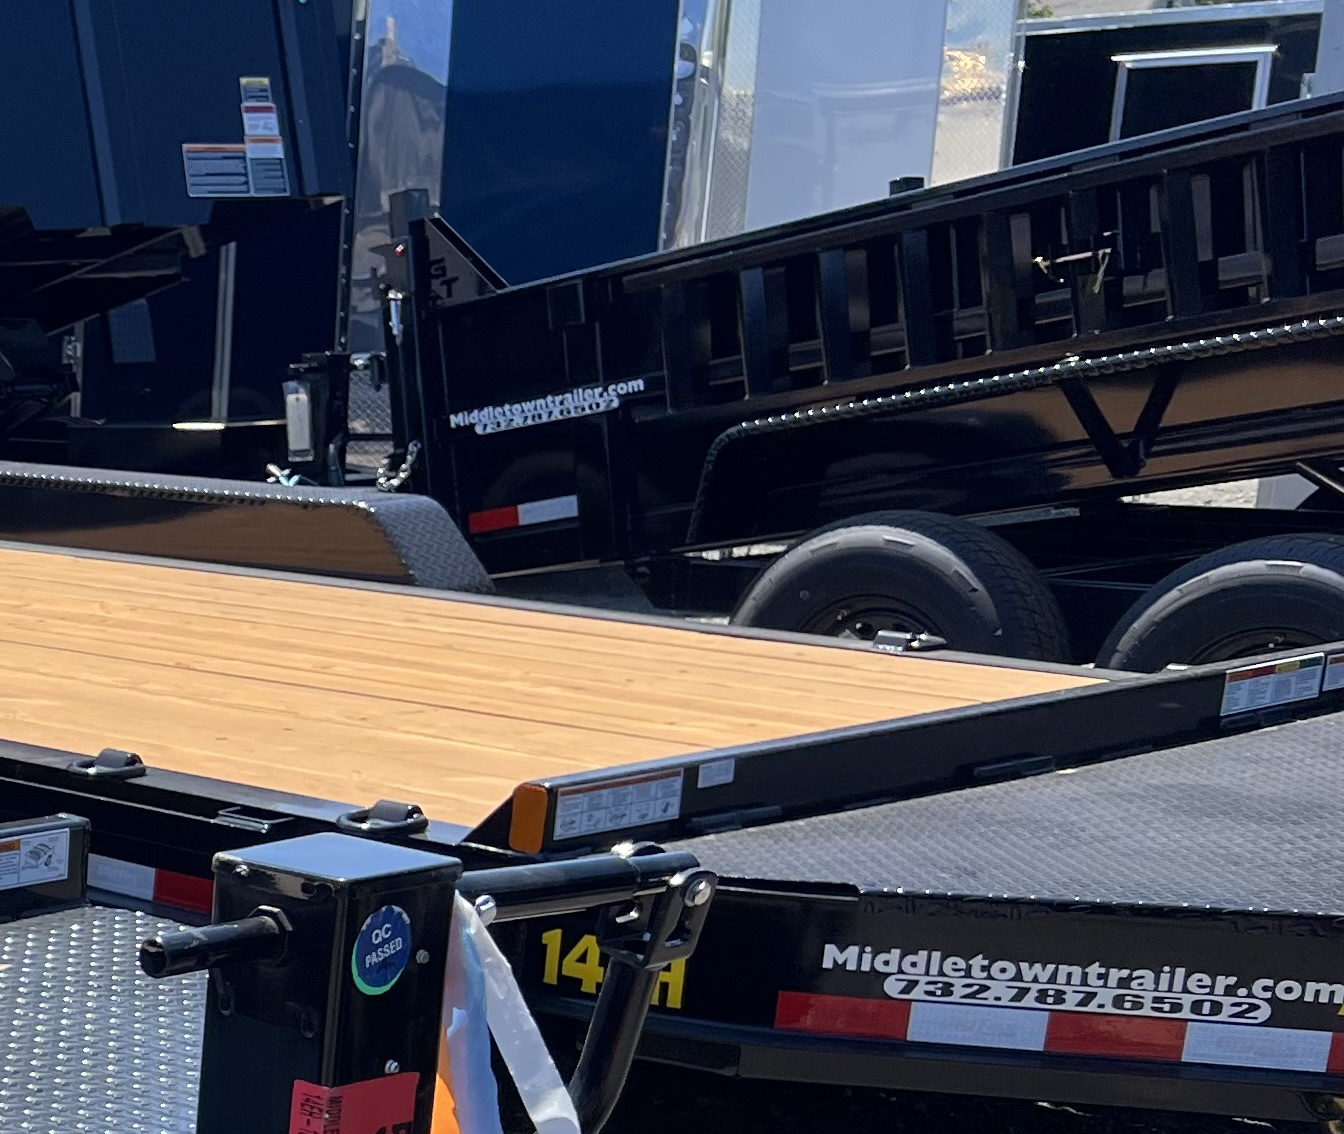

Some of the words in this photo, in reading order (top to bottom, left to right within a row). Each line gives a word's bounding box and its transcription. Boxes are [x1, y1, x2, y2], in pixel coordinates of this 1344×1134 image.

[450, 378, 644, 428] Middletowntrailer.com
[365, 937, 403, 968] PASSED
[372, 923, 392, 944] QC
[542, 929, 686, 1009] 14H
[822, 943, 1344, 1004] Middletowntrailer.com
[893, 978, 1262, 1022] 732.787.6502
